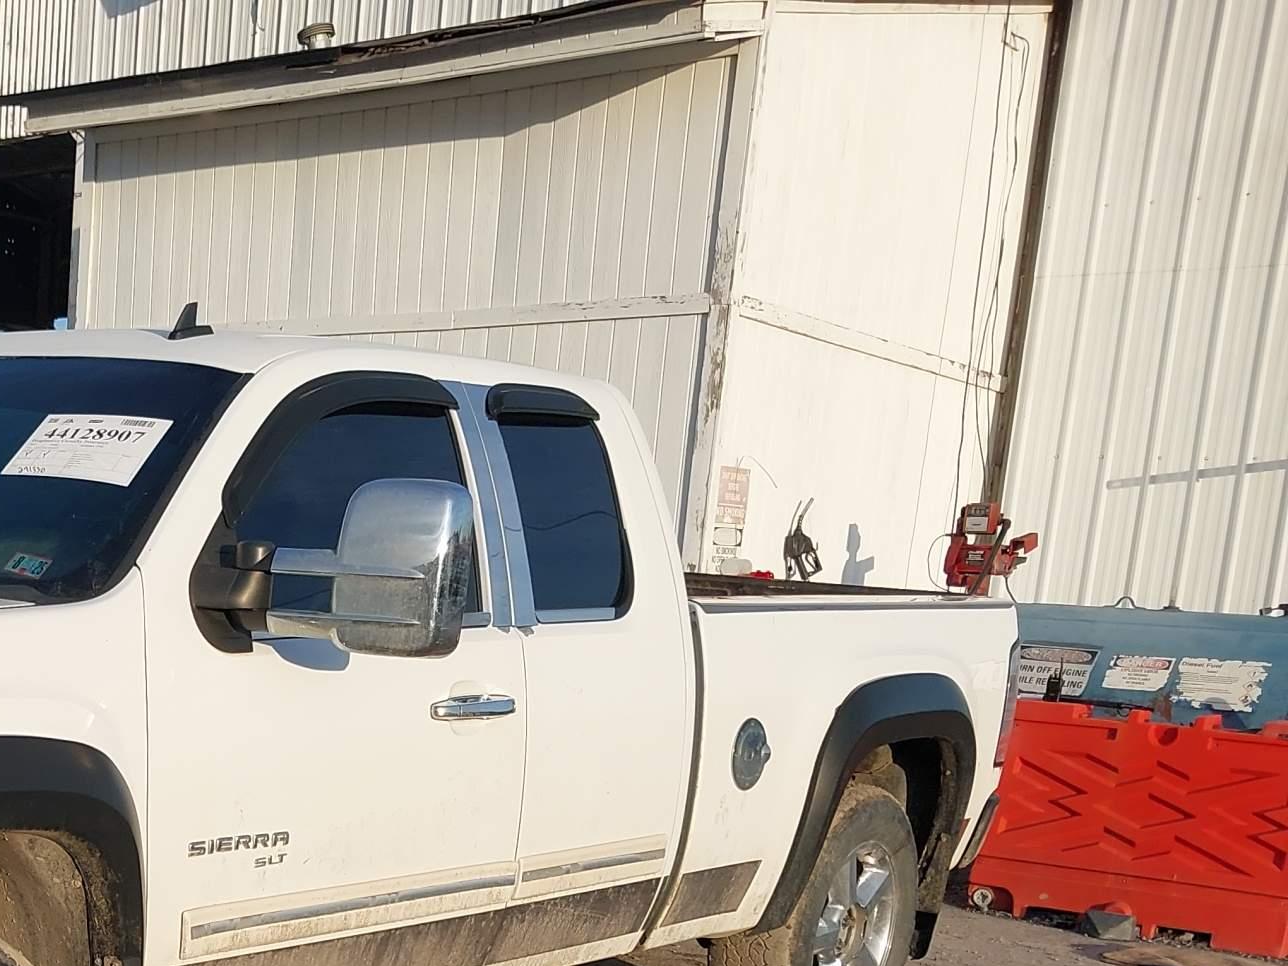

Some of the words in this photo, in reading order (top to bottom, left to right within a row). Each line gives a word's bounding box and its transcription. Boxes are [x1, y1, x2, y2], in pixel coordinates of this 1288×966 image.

[44, 427, 147, 443] 44128907
[1036, 666, 1052, 674] OFF
[1035, 677, 1084, 689] RELING
[187, 830, 290, 858] SIERRA
[254, 853, 288, 868] SLT
